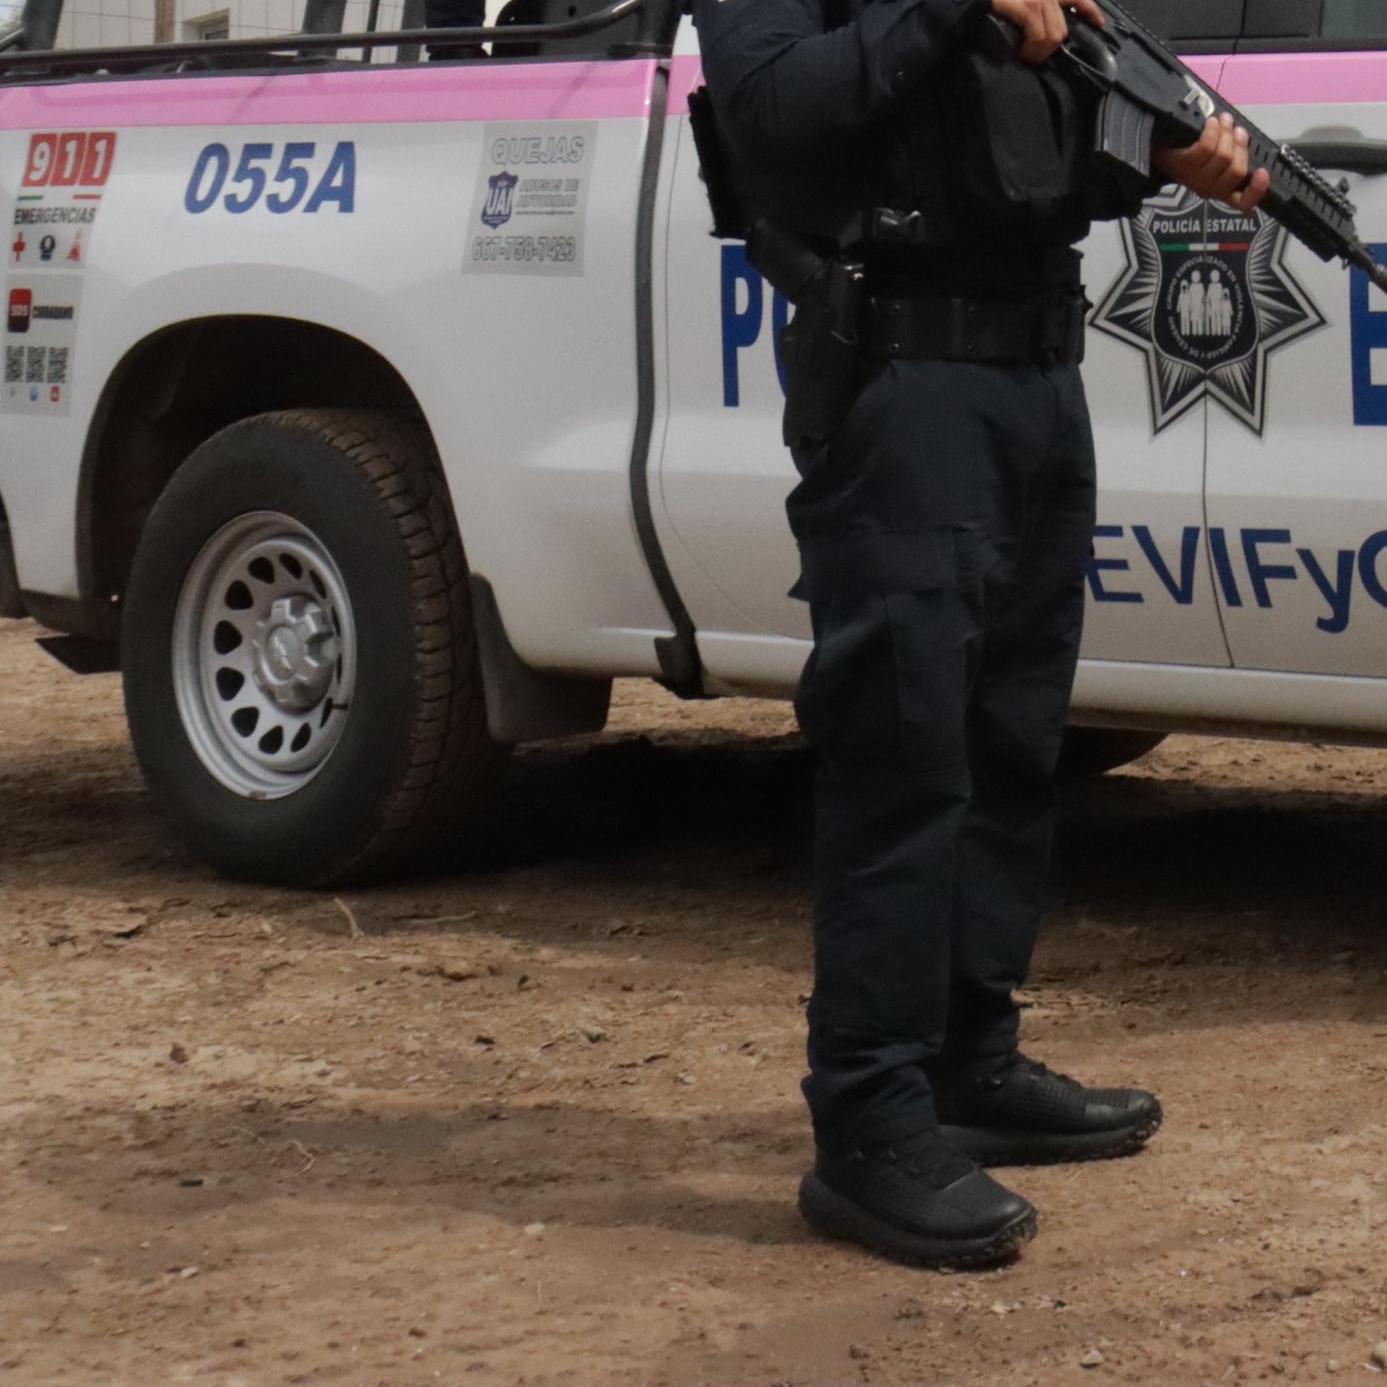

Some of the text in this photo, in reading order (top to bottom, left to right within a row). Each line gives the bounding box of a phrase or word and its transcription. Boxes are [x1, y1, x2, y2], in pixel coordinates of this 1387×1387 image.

[29, 138, 109, 182] 911
[491, 136, 585, 166] QUEJAS
[184, 141, 357, 214] 055A
[564, 178, 580, 192] DE
[14, 207, 97, 225] EMERGENCIAS
[1153, 218, 1257, 233] POLICÍA ESTATAL
[11, 305, 29, 317] SOS
